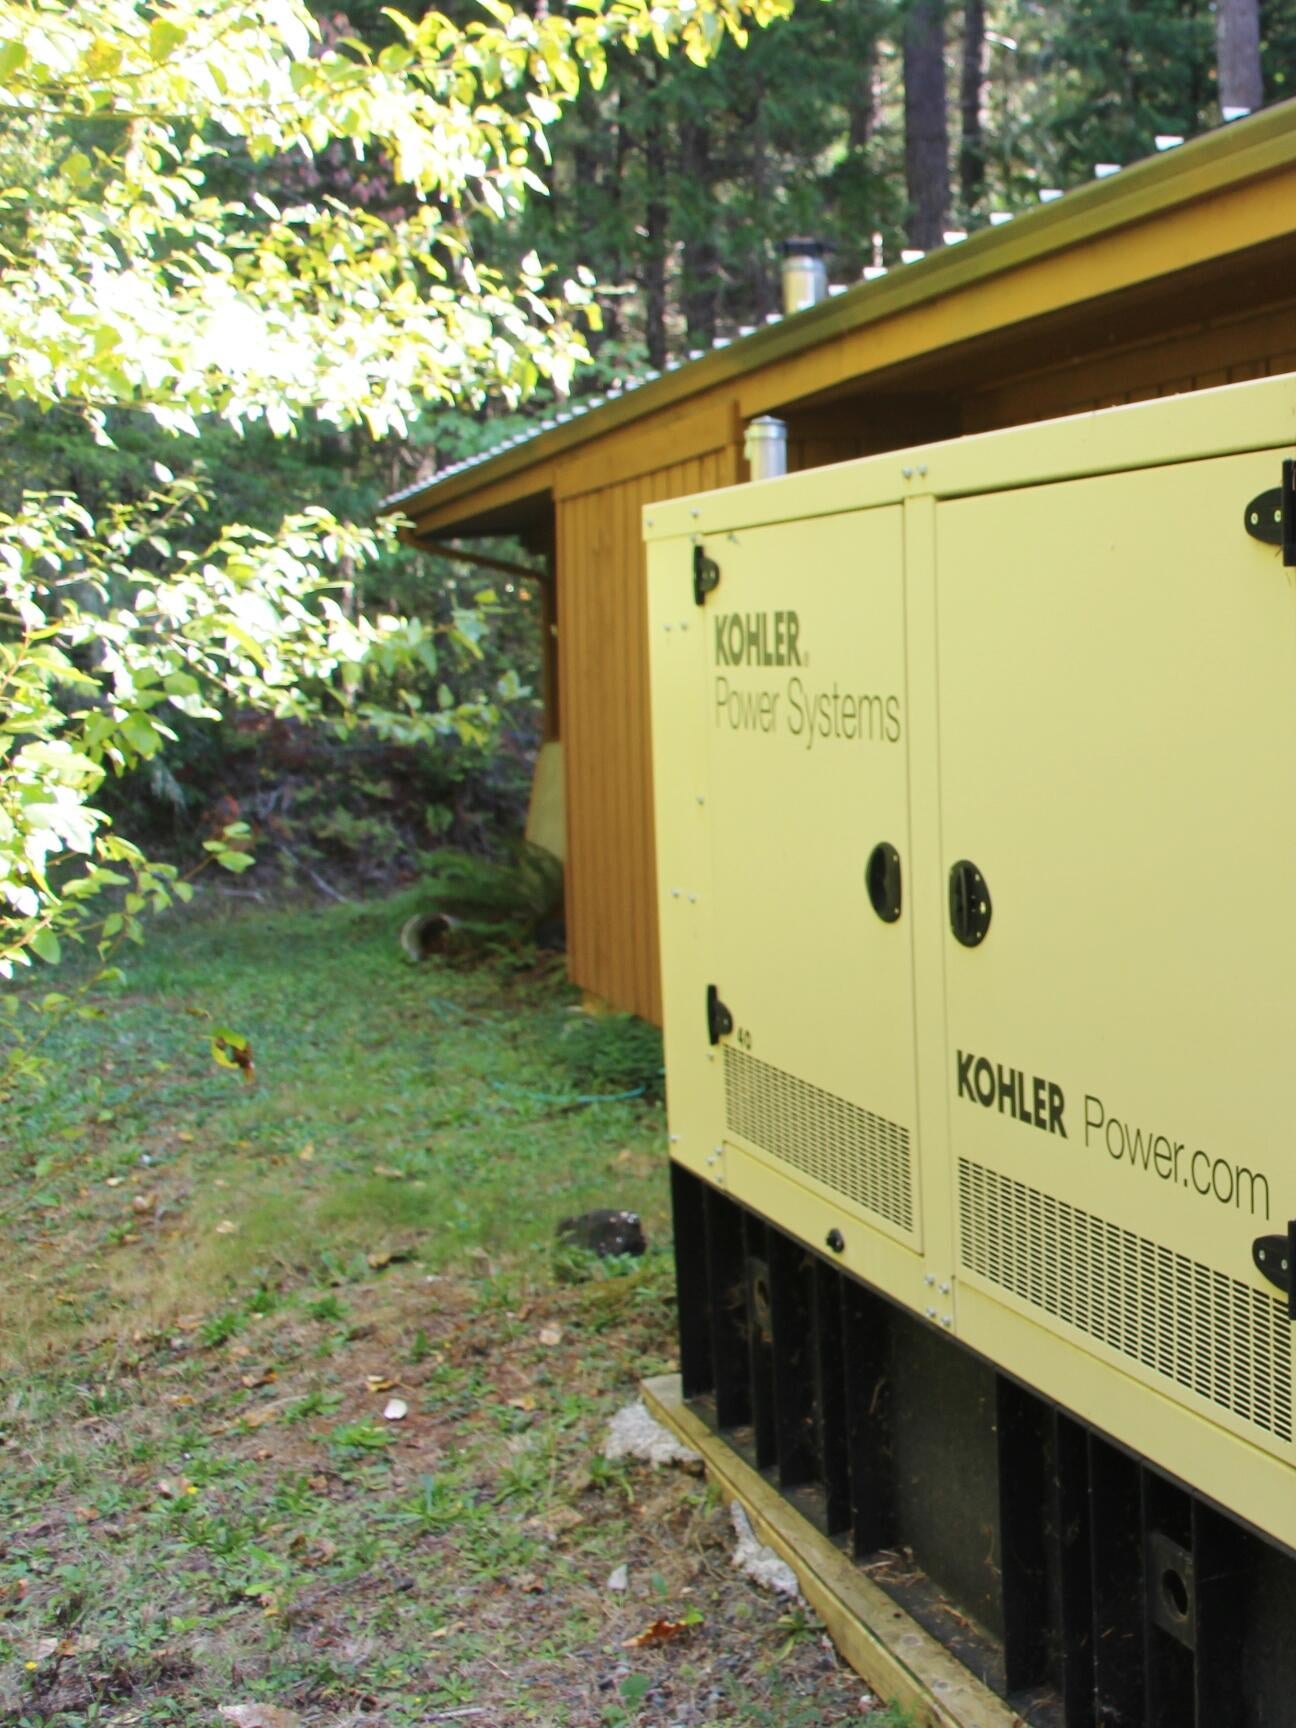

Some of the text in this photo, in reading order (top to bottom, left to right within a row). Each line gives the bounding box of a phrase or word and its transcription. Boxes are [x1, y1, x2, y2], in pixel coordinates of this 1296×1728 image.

[714, 610, 802, 666] KOHLER
[715, 676, 900, 750] Power Systems
[956, 1049, 1270, 1221] KOHLER Power.com
